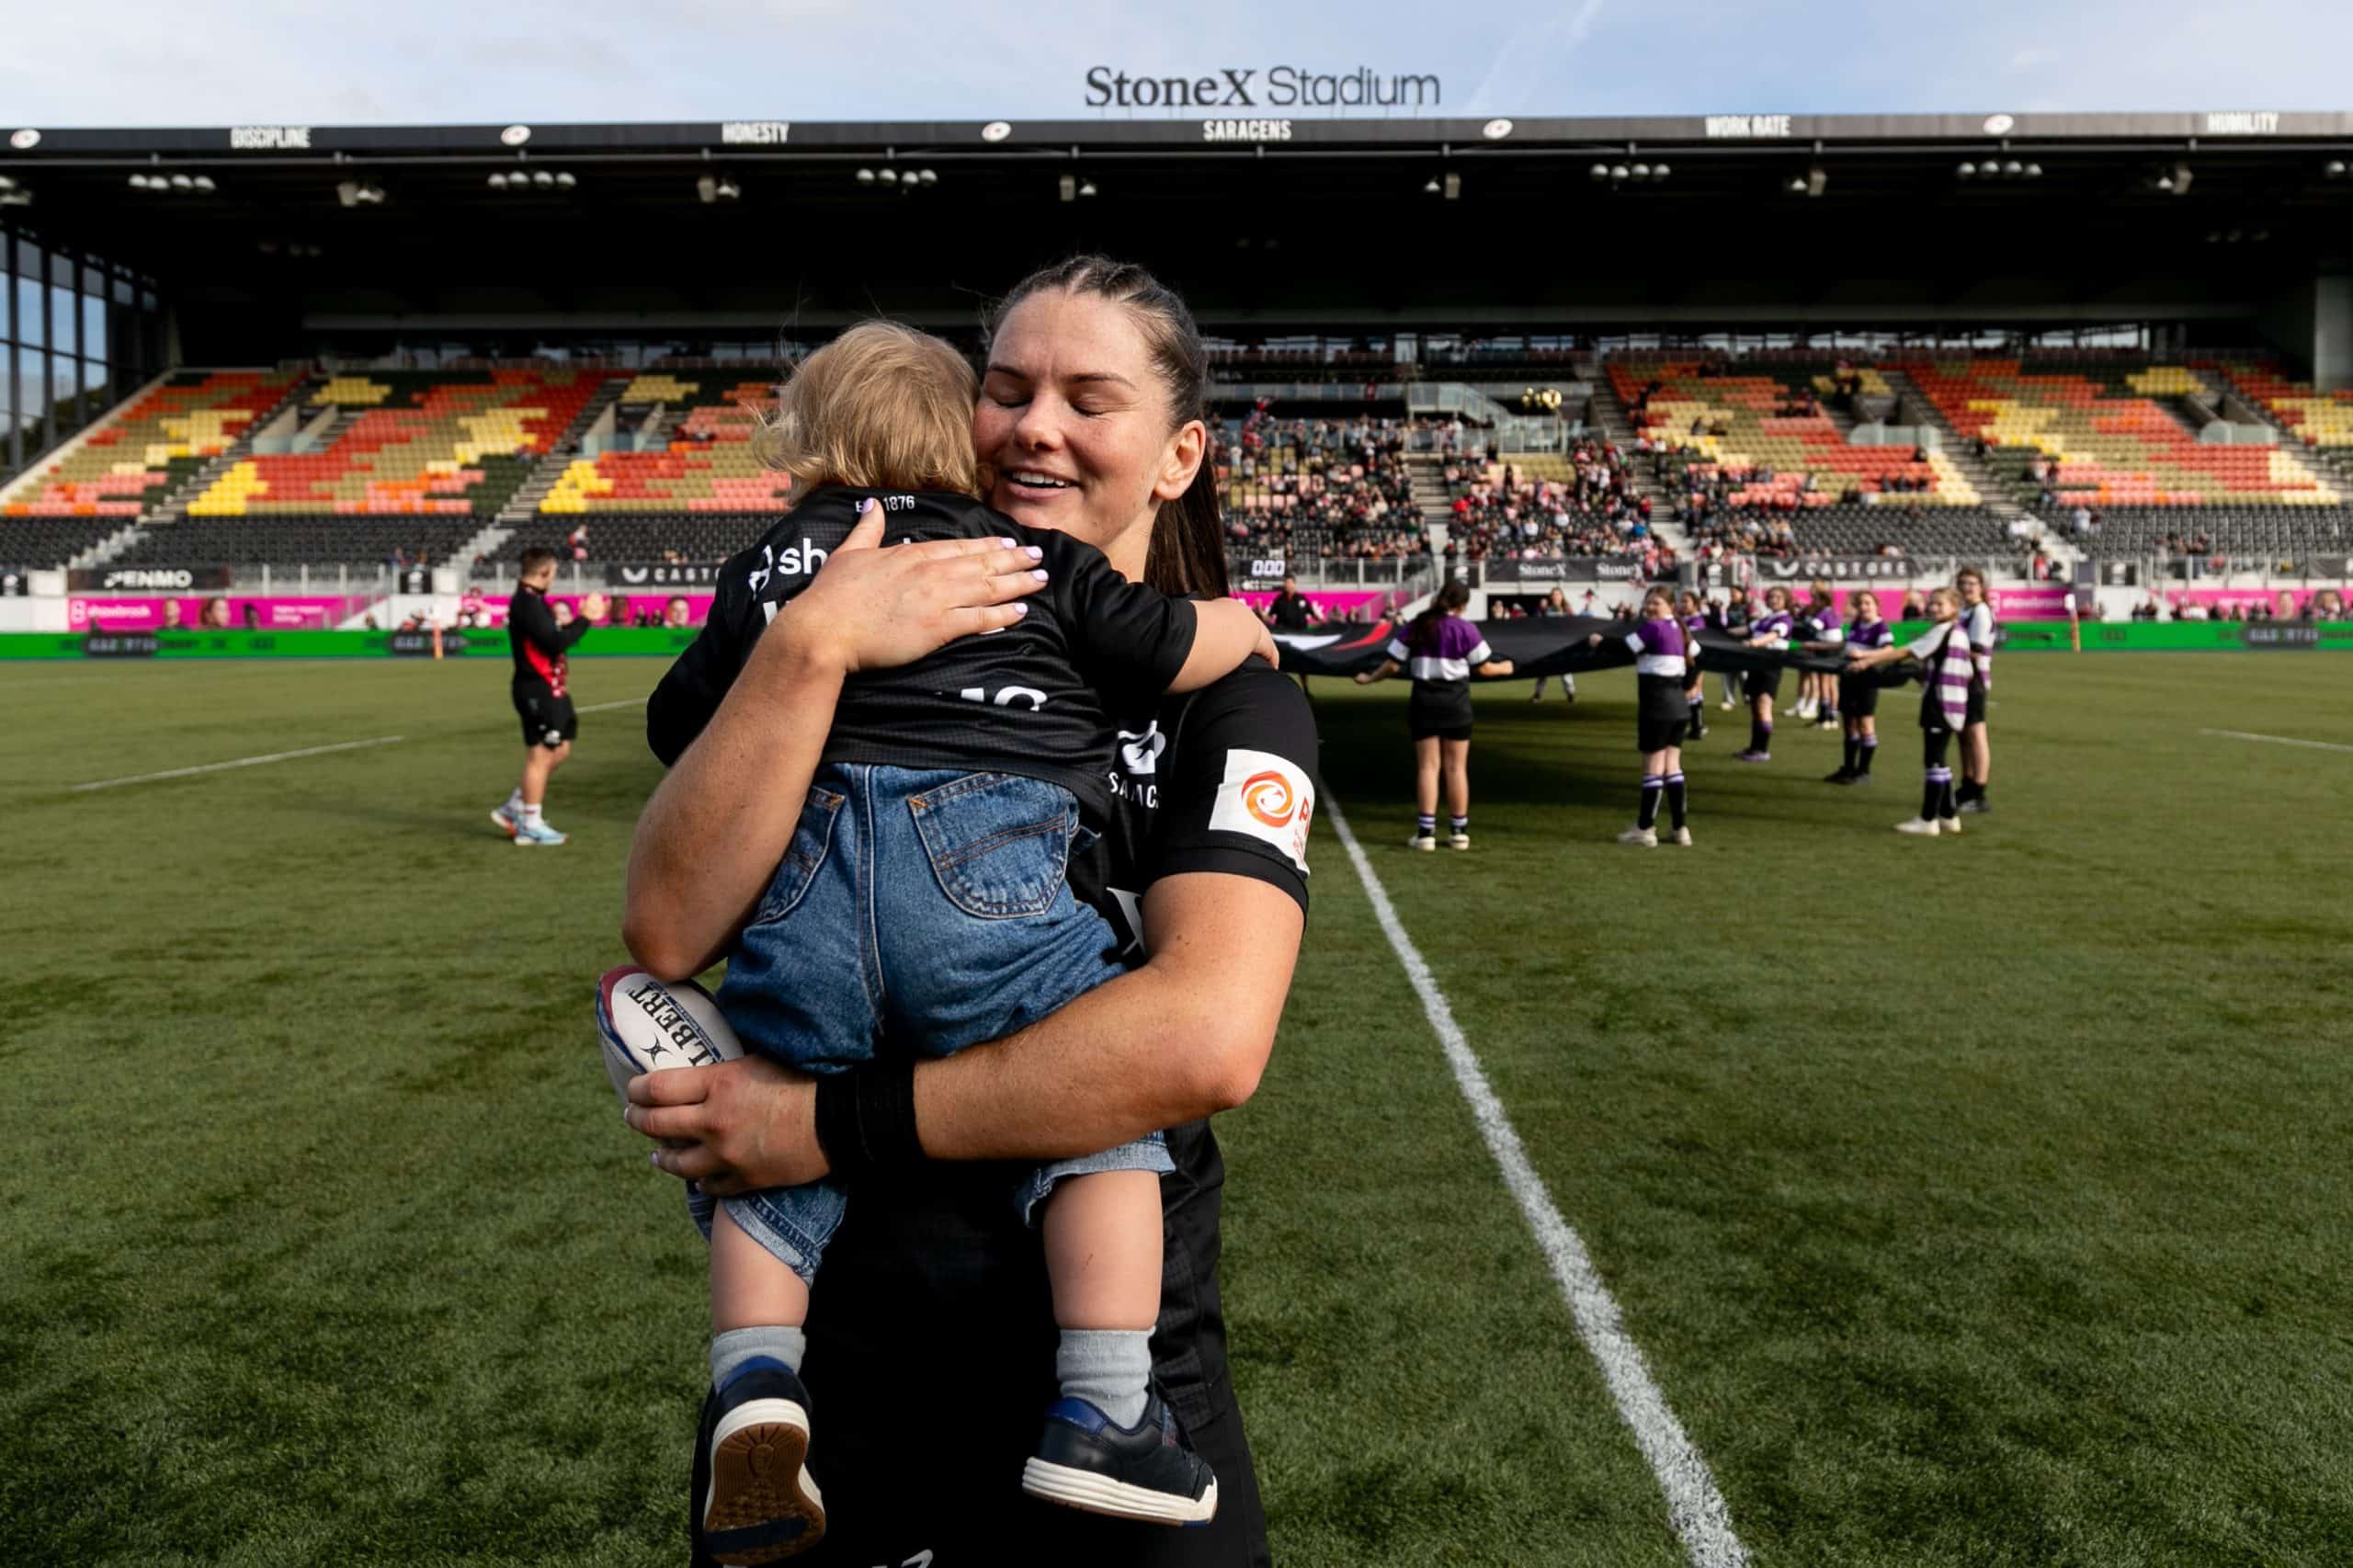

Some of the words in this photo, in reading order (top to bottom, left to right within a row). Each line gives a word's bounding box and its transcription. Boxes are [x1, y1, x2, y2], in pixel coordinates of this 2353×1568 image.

[1085, 65, 1257, 107] StoneX
[1267, 65, 1441, 106] Stadium
[1203, 119, 1292, 142] SARACENS
[882, 494, 915, 512] 1876
[654, 567, 722, 582] CAST
[1804, 561, 1907, 576] CASTORE
